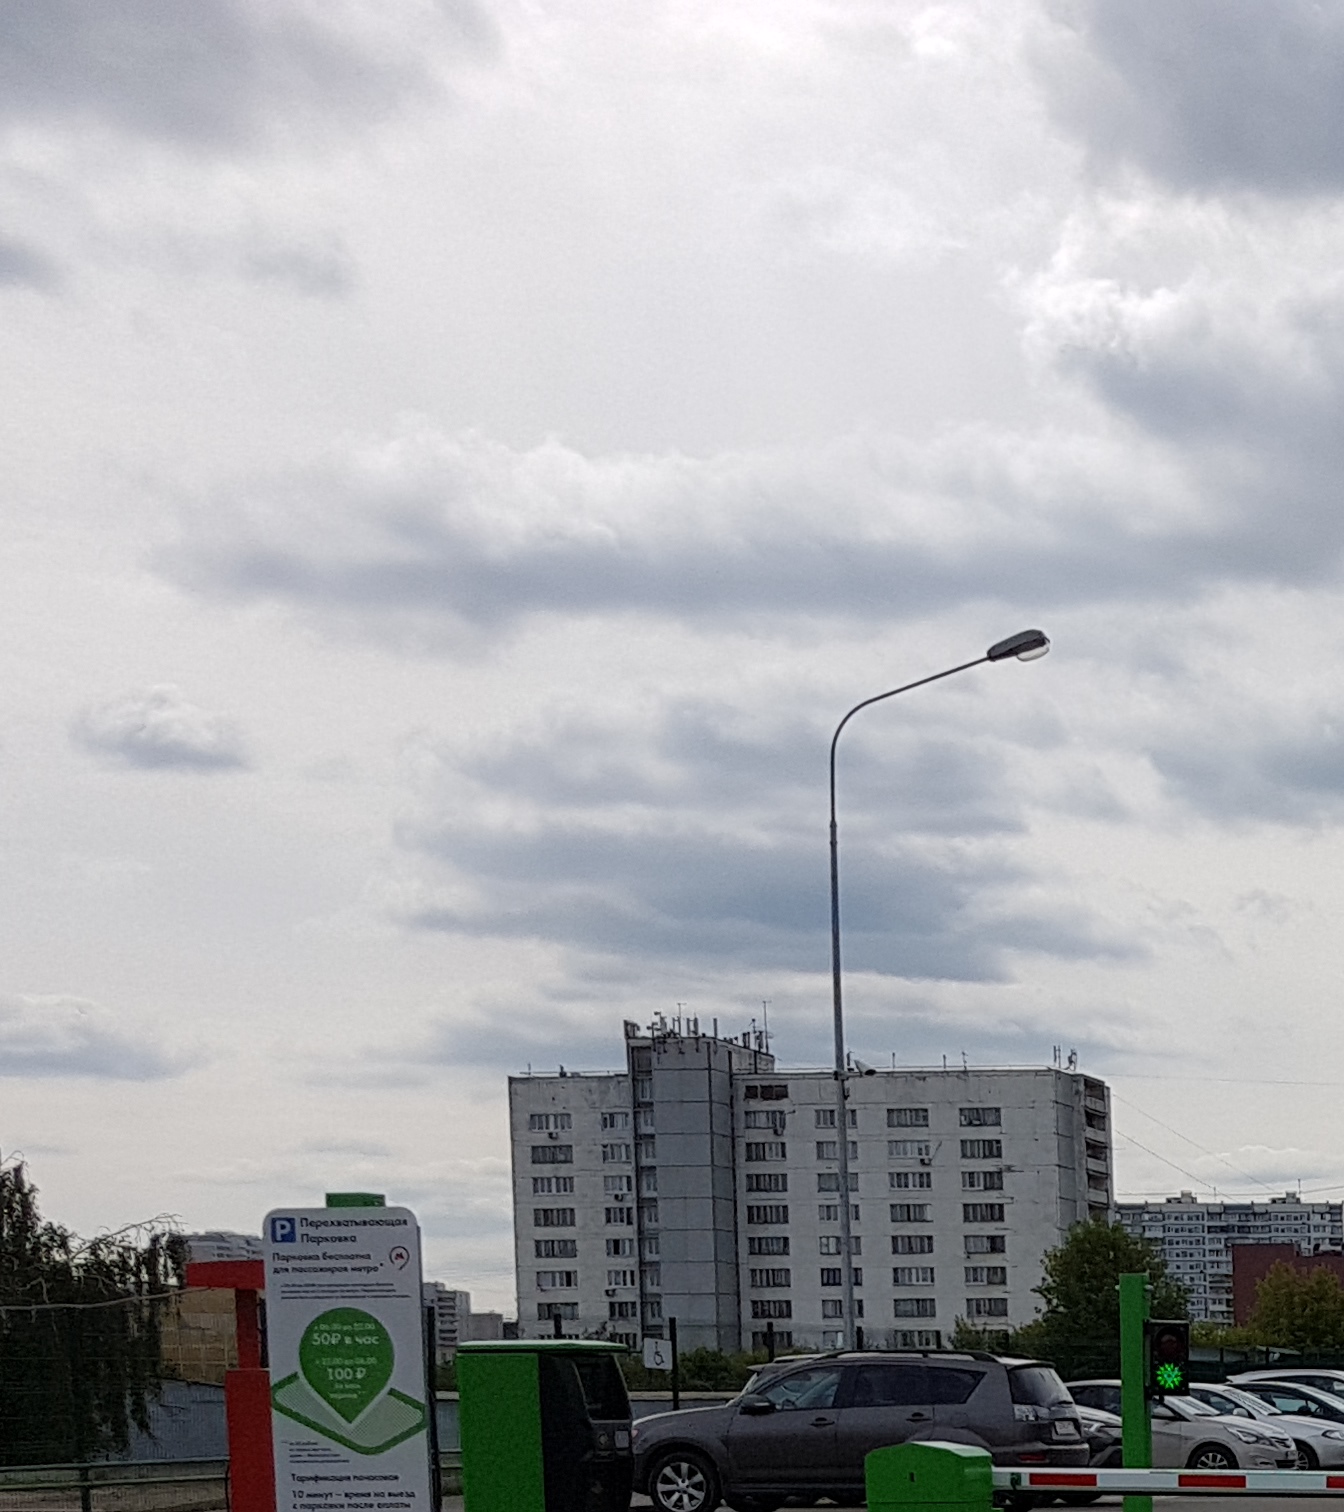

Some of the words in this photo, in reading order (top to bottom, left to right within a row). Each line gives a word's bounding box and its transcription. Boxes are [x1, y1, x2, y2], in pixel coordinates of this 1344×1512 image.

[300, 1218, 408, 1230] Перехватывающая
[275, 1220, 291, 1241] P
[301, 1234, 357, 1246] Парковка
[272, 1252, 320, 1263] Парковка
[326, 1367, 353, 1380] 100
[292, 1490, 304, 1499] 10
